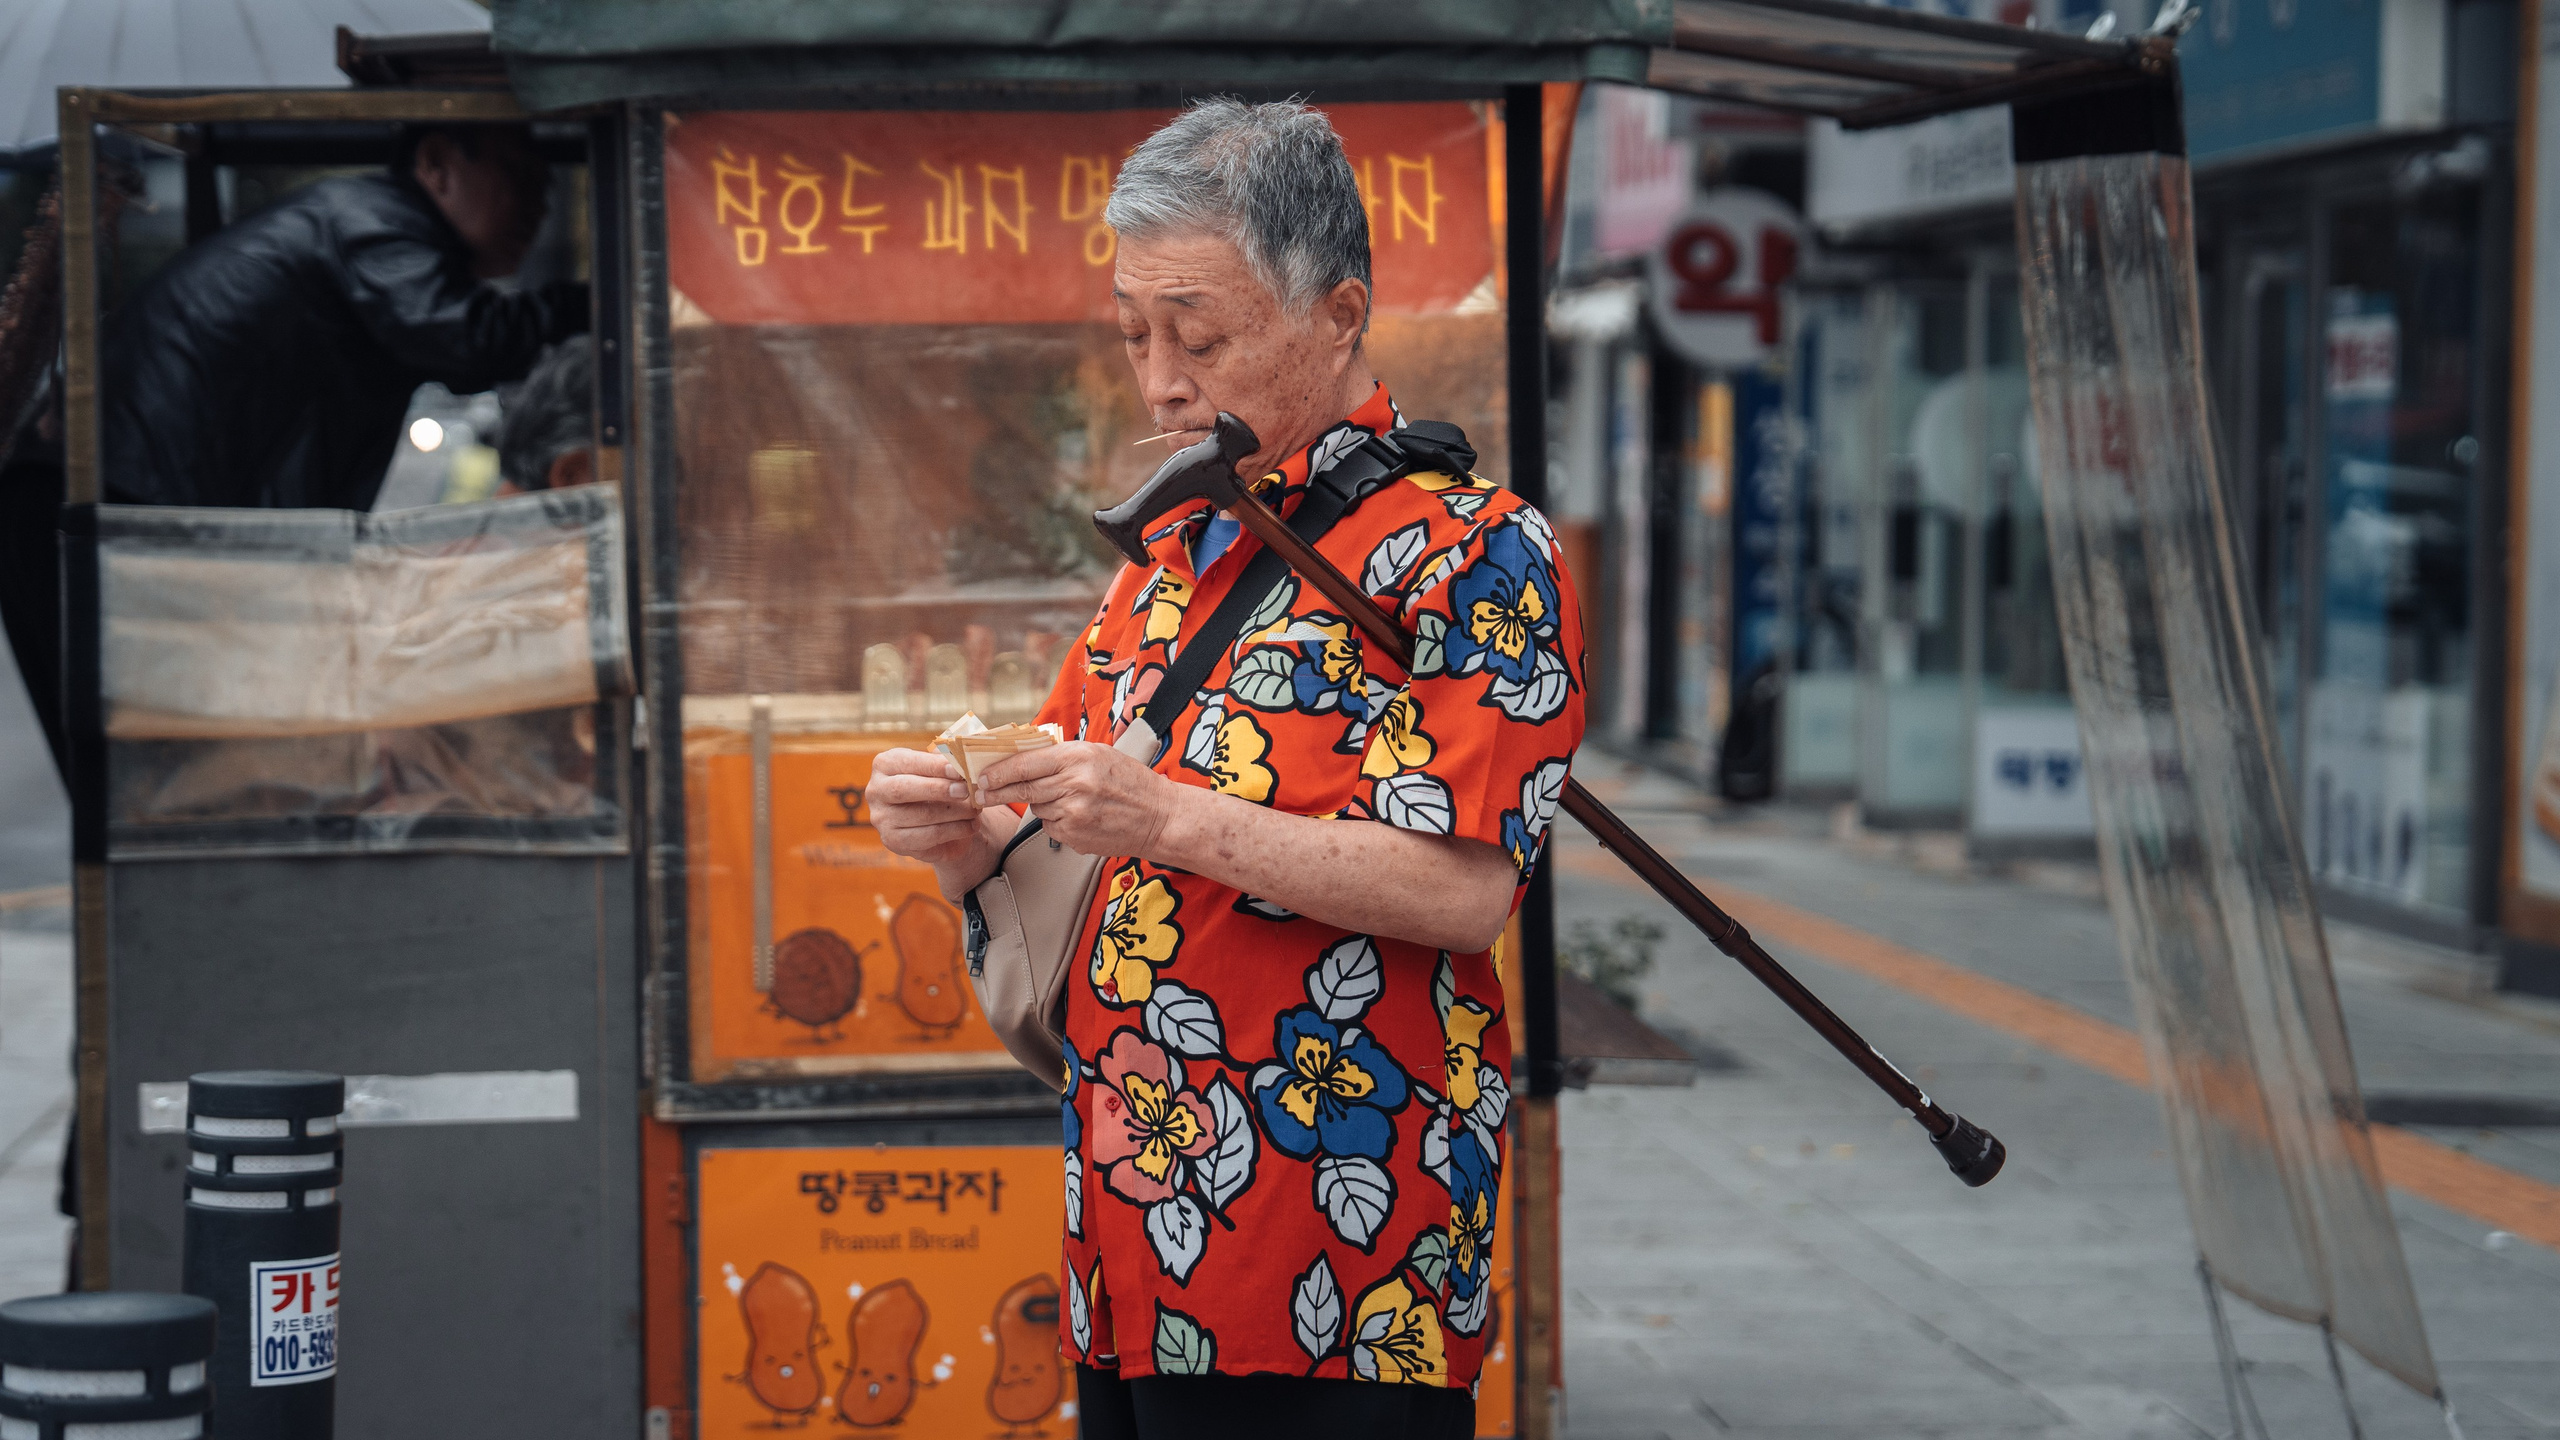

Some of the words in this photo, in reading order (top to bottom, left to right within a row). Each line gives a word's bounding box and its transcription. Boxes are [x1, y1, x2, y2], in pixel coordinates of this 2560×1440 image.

[711, 147, 889, 267] 참호두
[919, 158, 1036, 255] 과자
[799, 1168, 1006, 1215] 땅콩과자
[820, 1227, 901, 1252] Peanut
[908, 1225, 980, 1250] Bread
